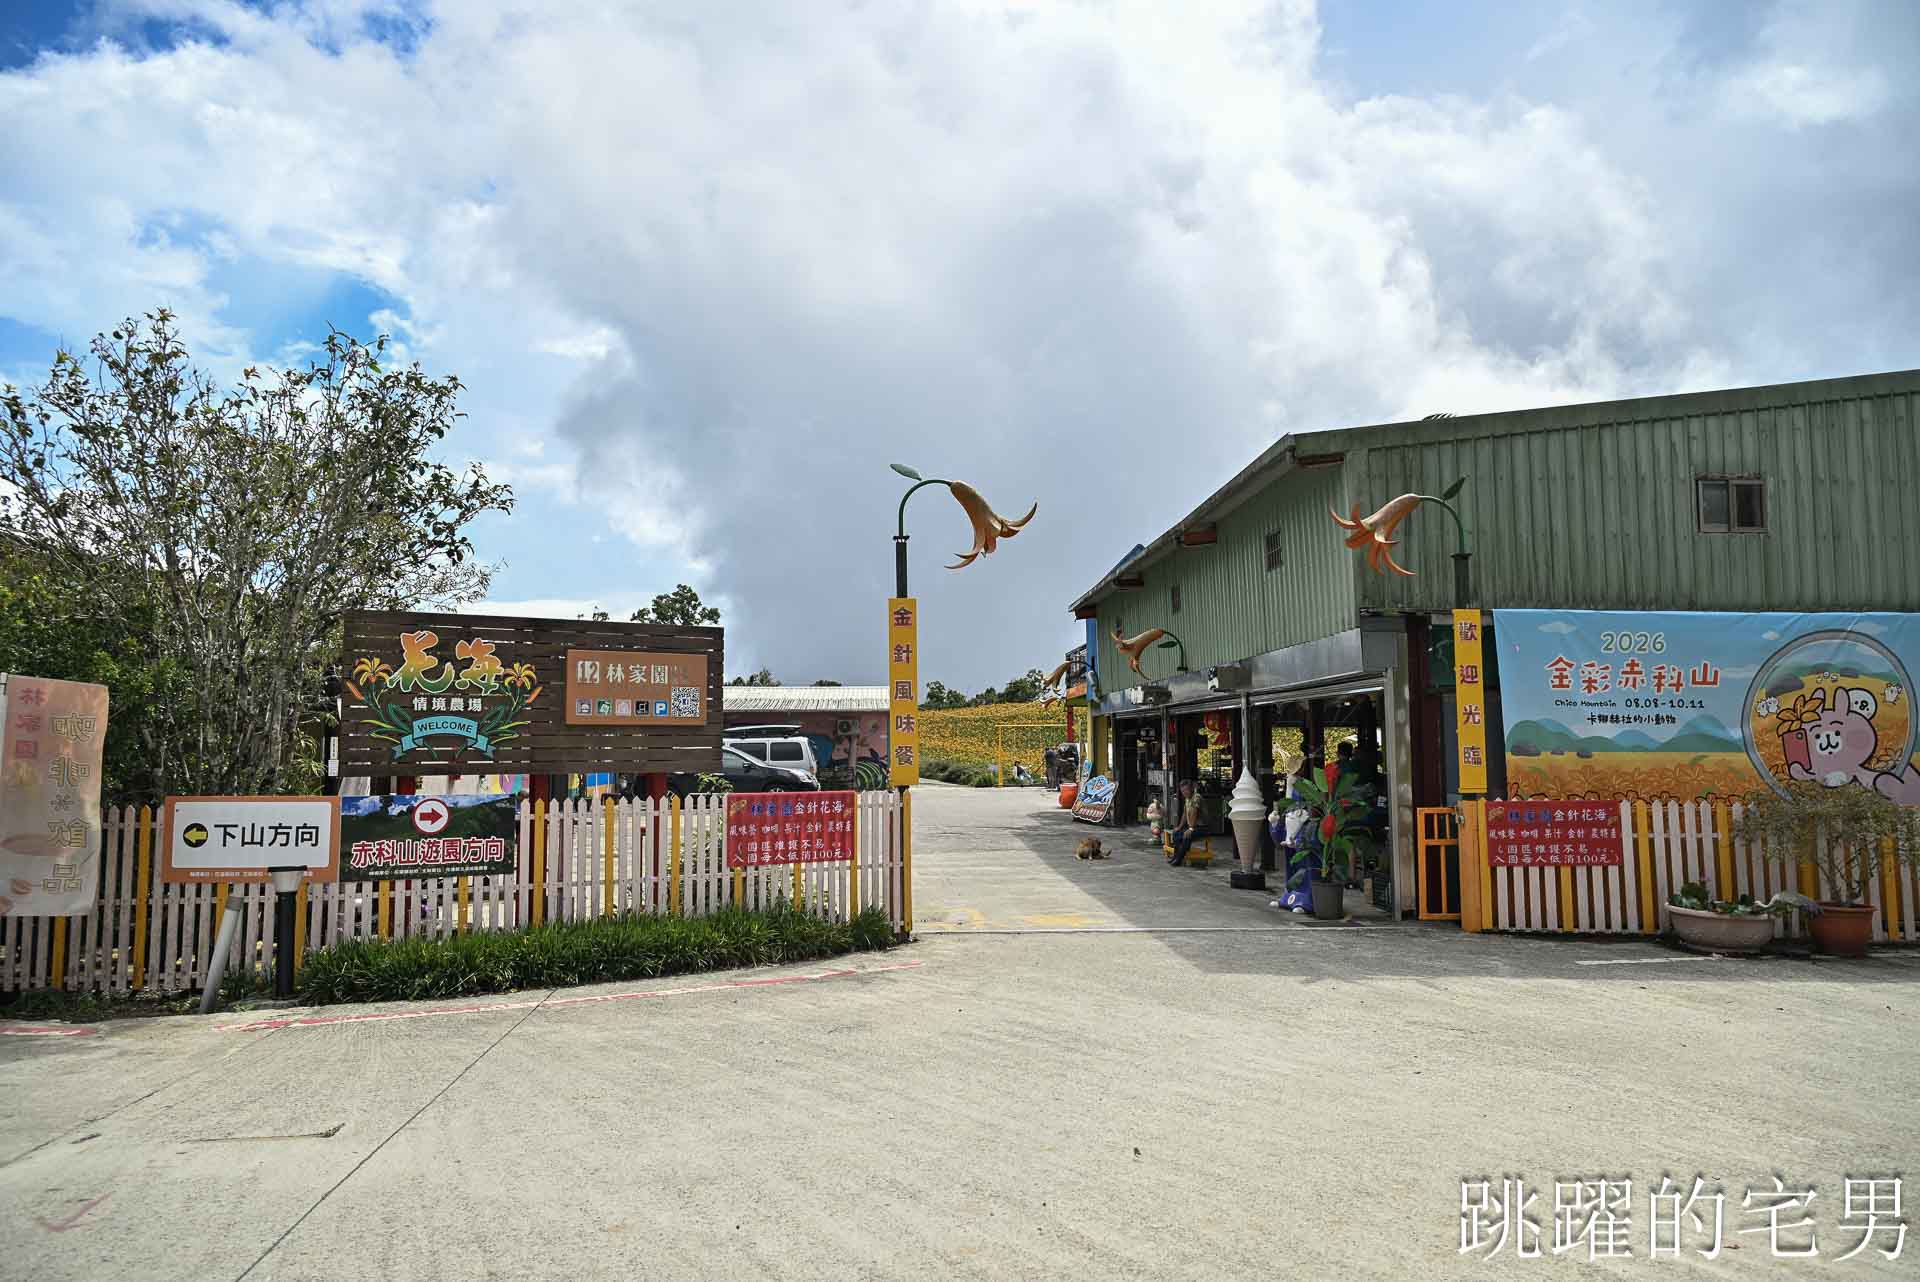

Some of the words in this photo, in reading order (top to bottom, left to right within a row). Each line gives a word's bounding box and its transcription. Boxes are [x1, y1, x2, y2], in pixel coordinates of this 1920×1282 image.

[1600, 631, 1667, 654] 2026
[606, 664, 669, 684] 林家園
[1545, 655, 1721, 695] 金彩赤科山
[893, 607, 915, 766] 金針風味餐
[1457, 621, 1483, 767] 歡迎光臨
[413, 697, 483, 713] 情境農場
[1581, 699, 1617, 709] Mountain
[1625, 698, 1705, 709] 08.08-10.11
[417, 721, 474, 734] WELCOME
[213, 822, 320, 848] 下山方向
[352, 837, 504, 866] 赤科山遊園方向
